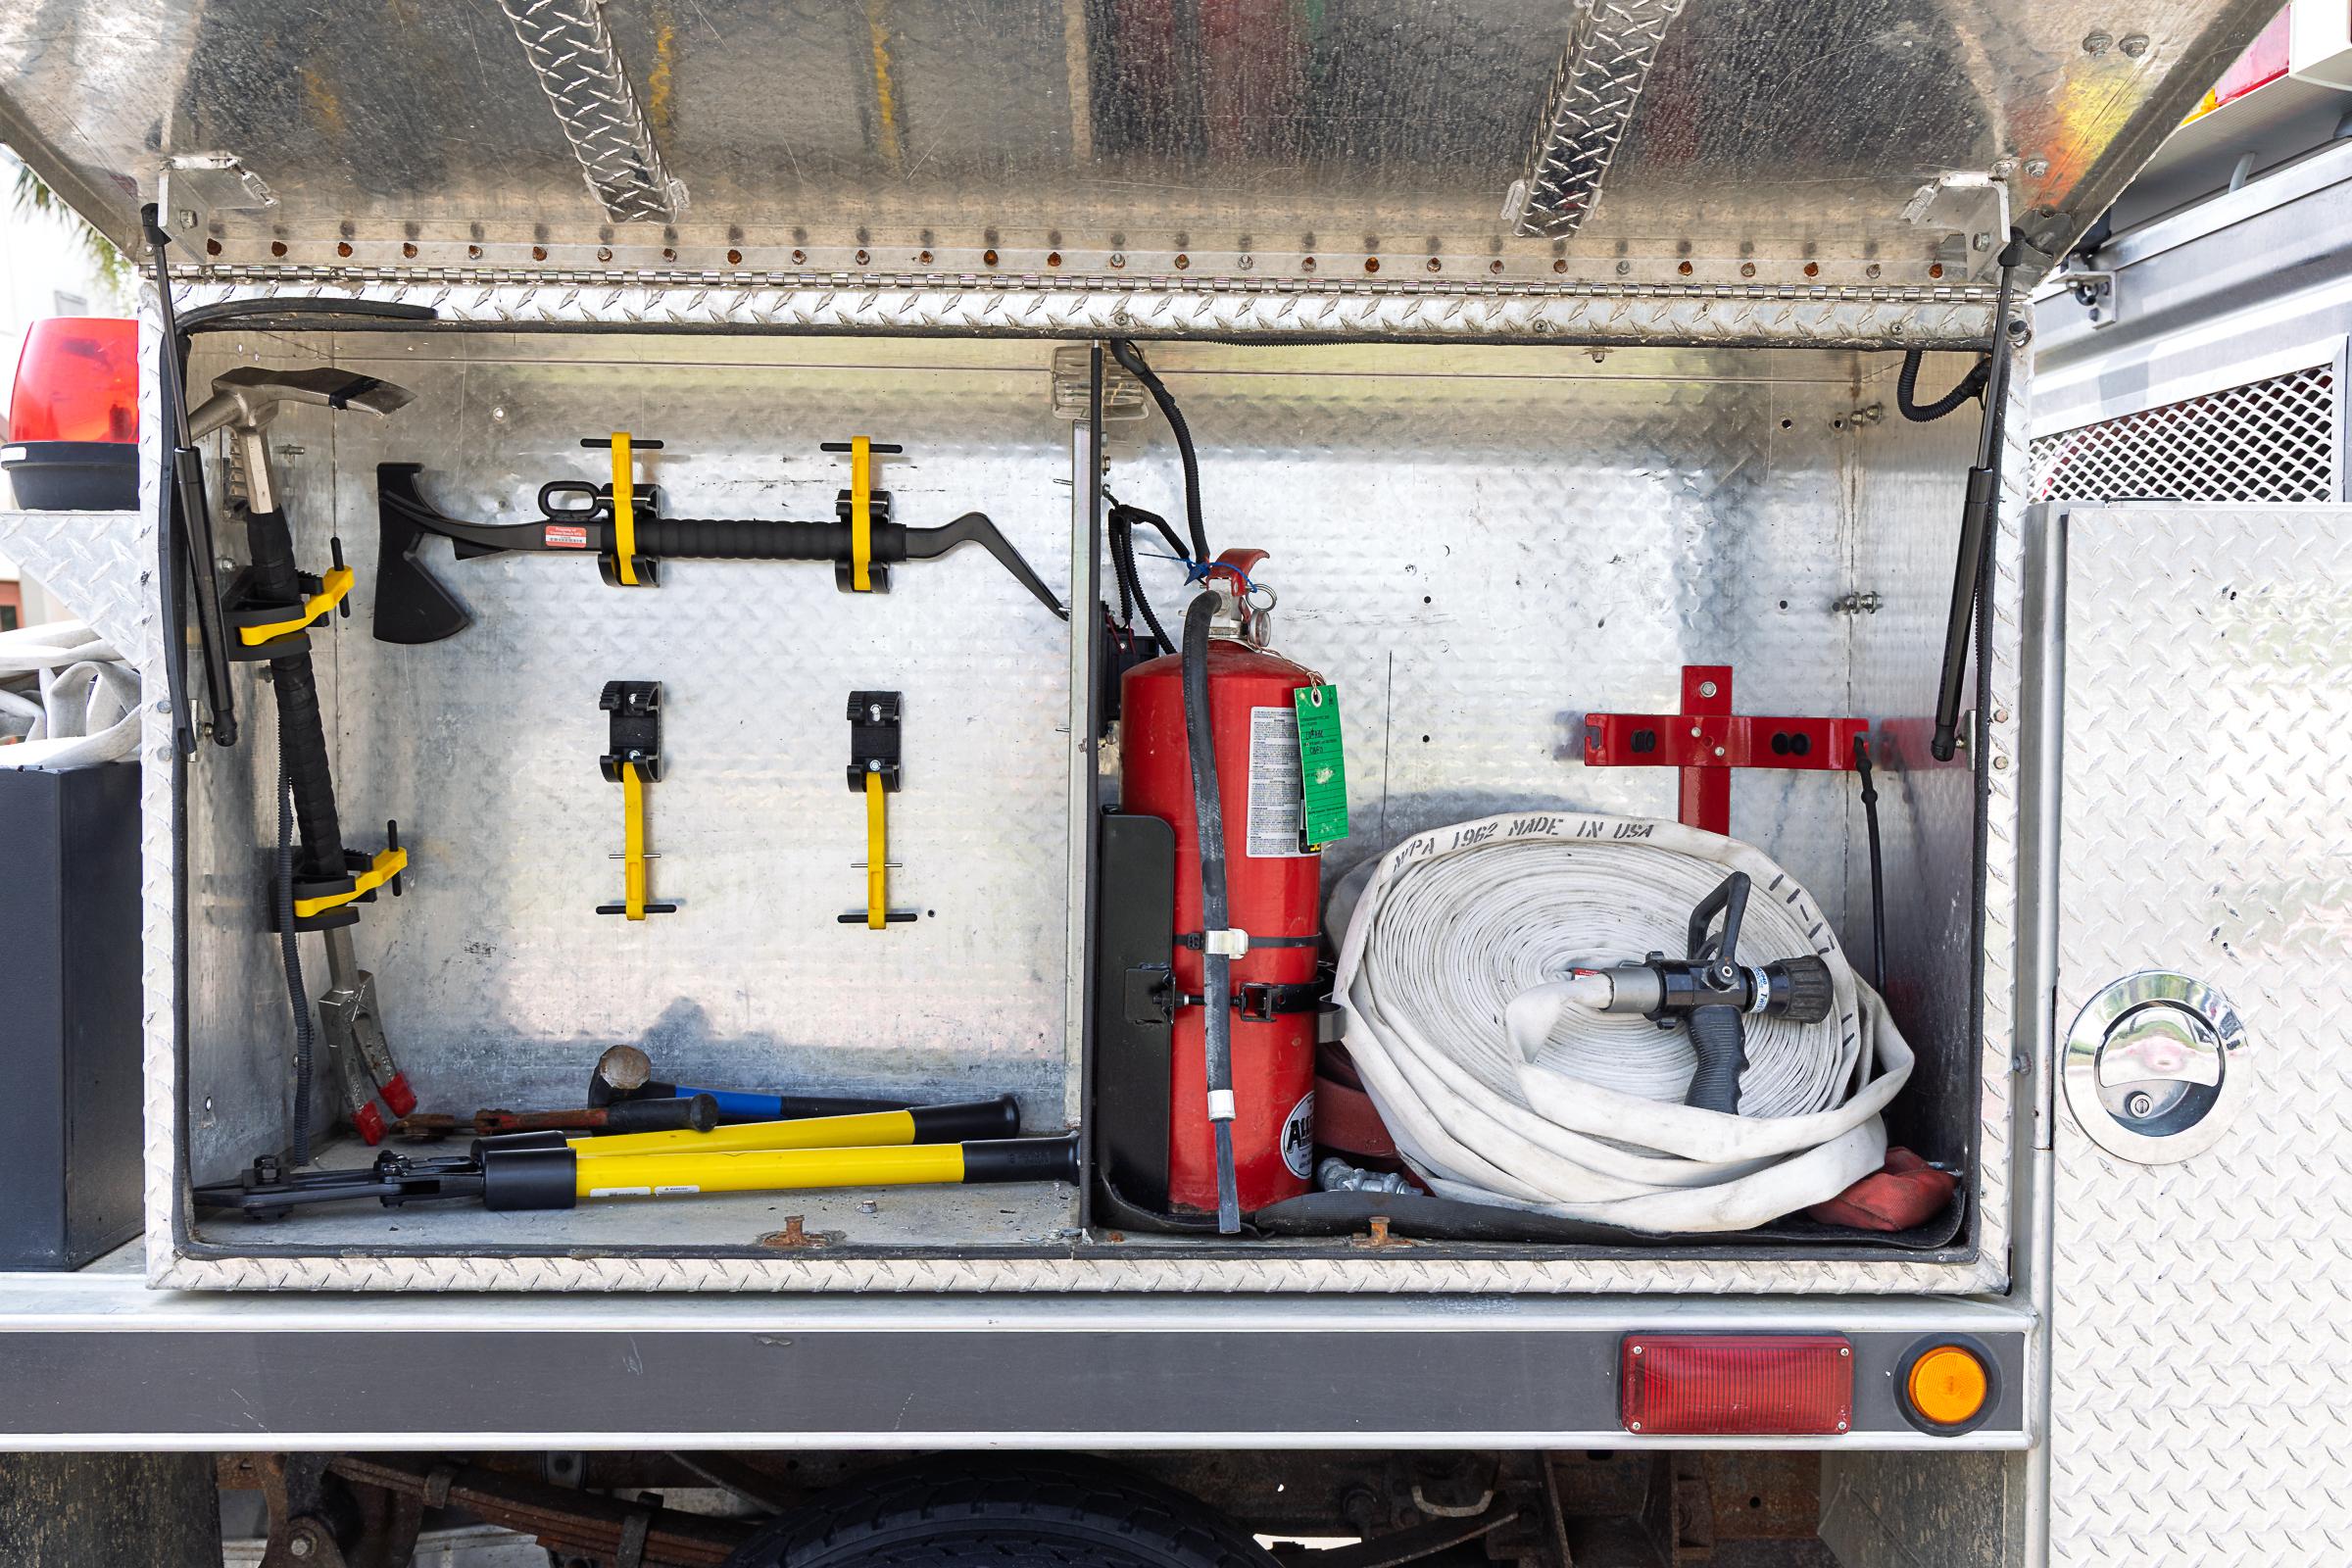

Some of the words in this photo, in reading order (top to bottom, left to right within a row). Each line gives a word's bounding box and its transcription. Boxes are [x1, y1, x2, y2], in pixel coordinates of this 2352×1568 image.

[1451, 821, 1498, 850] 1962
[1508, 816, 1563, 837] MADE
[1577, 820, 1603, 839] IN
[1613, 823, 1654, 839] USA
